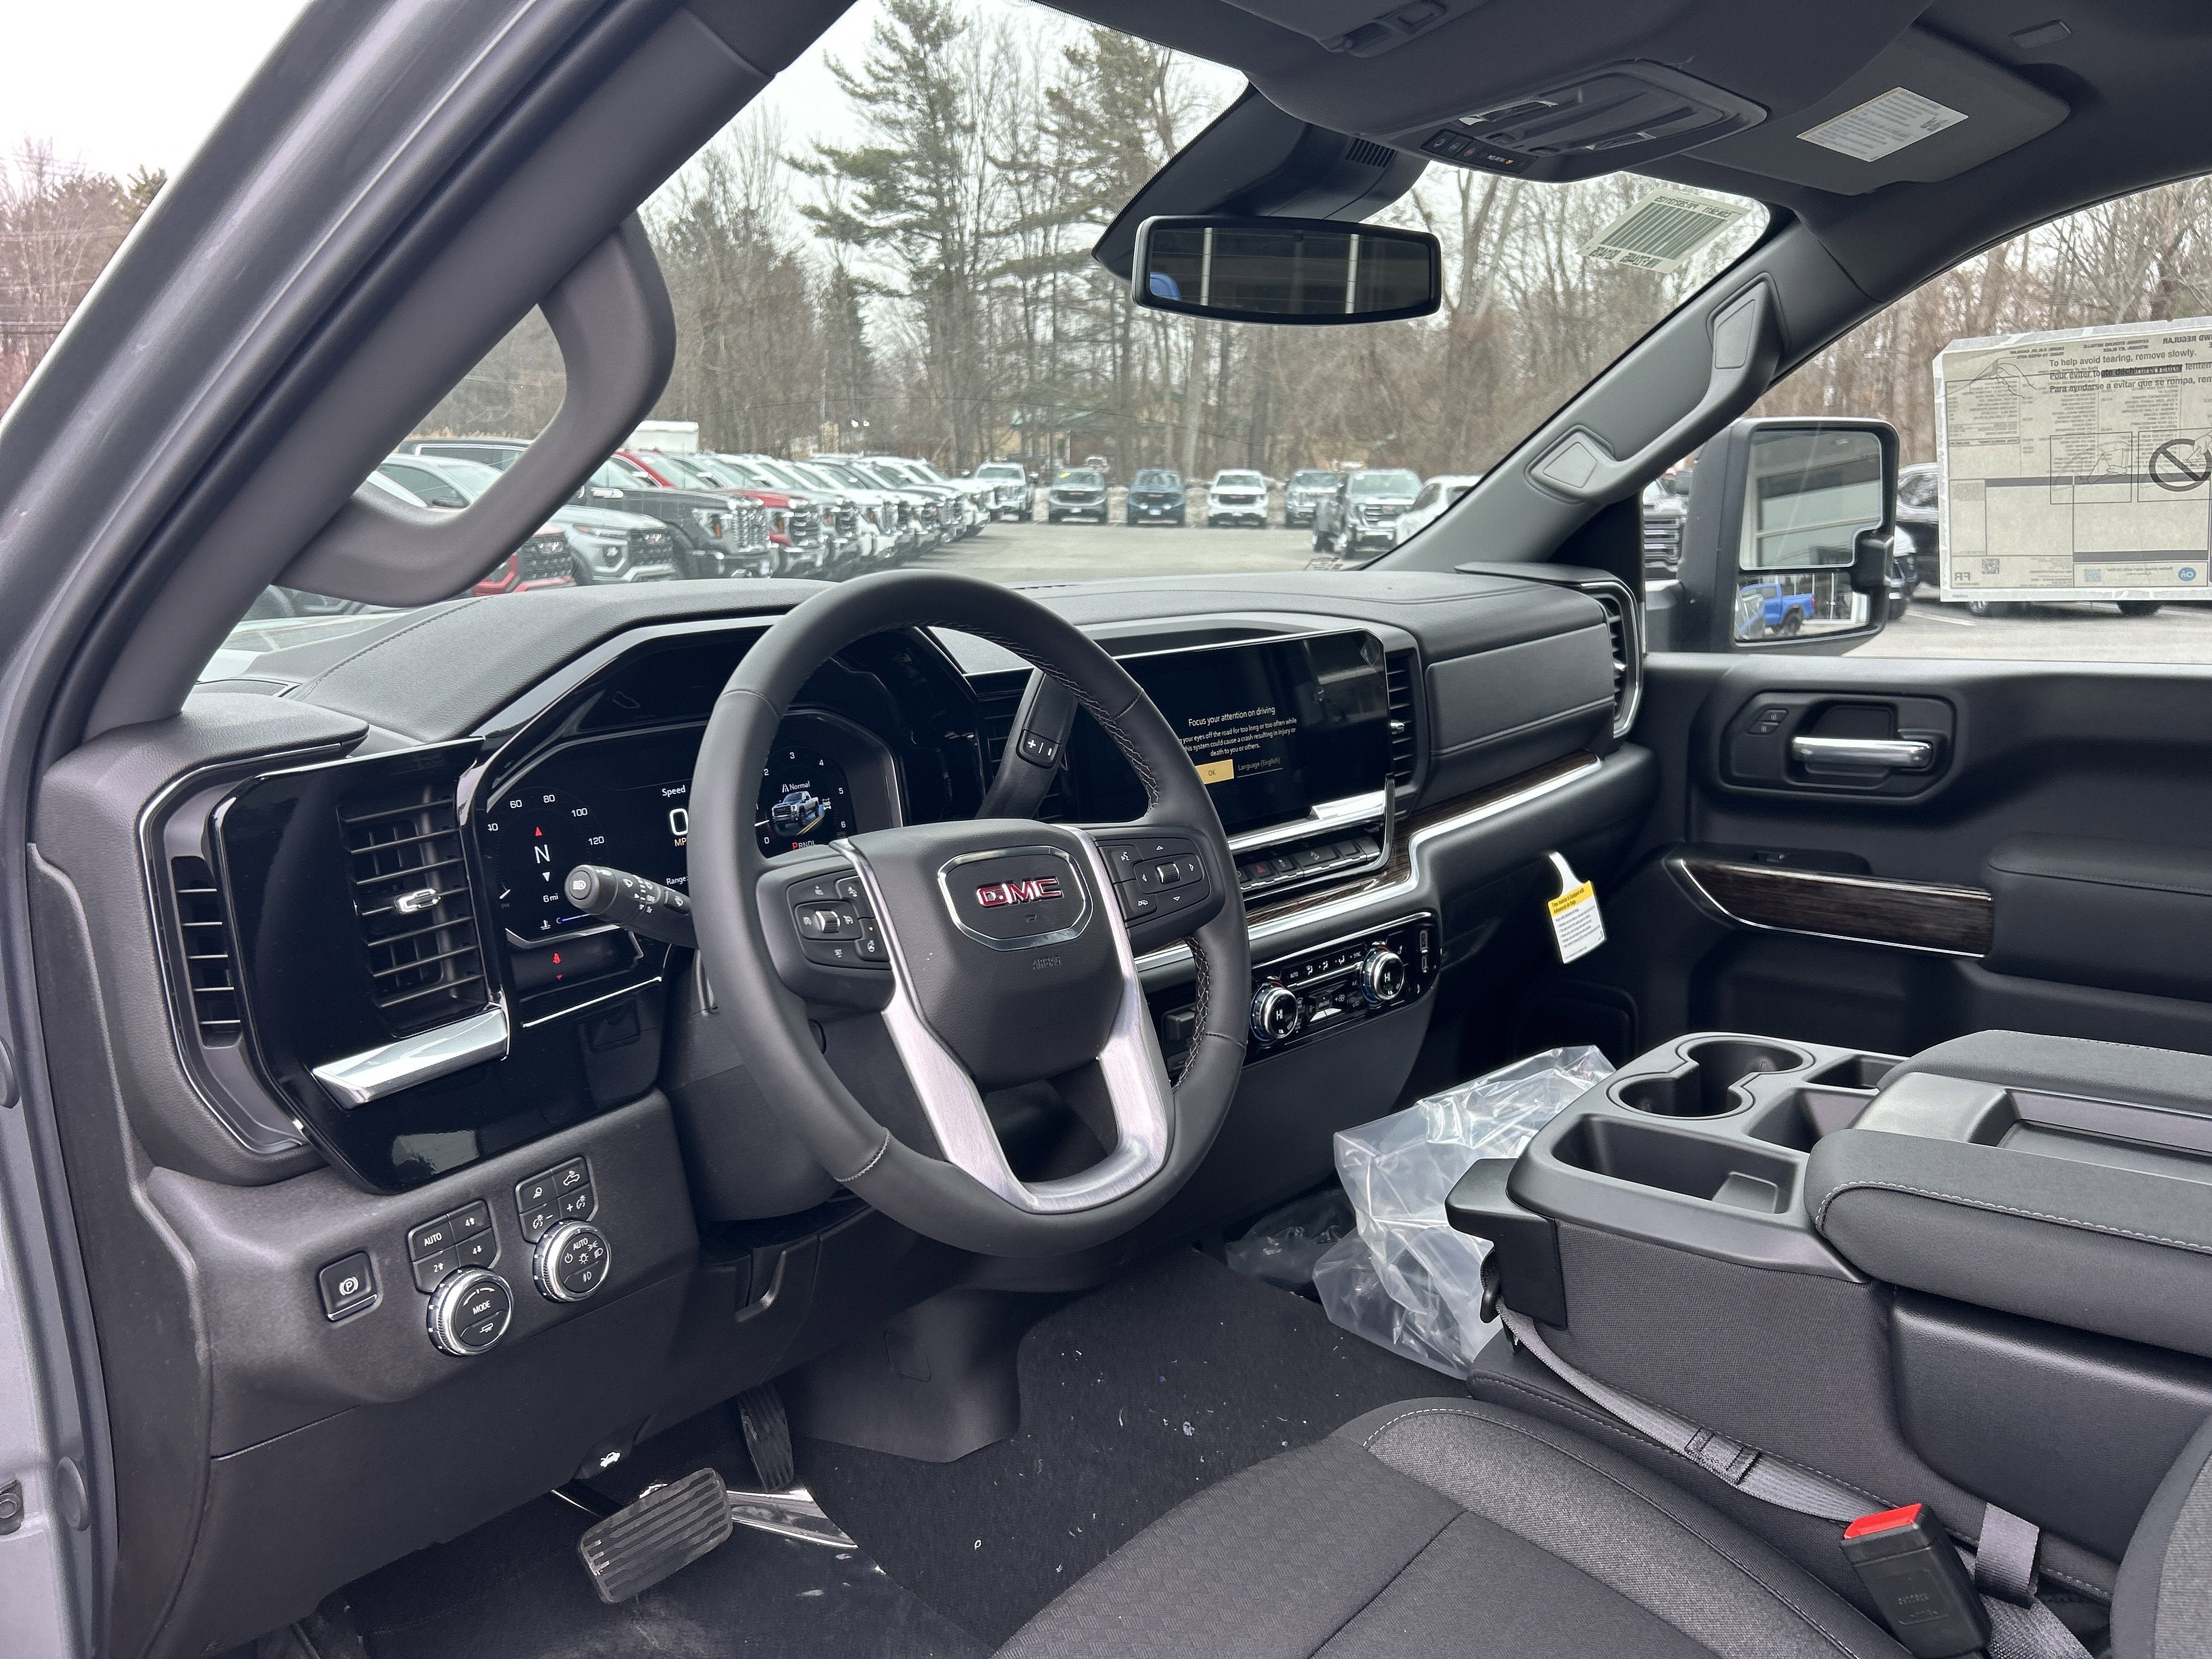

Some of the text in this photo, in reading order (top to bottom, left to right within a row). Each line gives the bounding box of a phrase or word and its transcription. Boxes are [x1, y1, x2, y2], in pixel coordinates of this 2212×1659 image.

[2061, 358, 2078, 366] help
[2079, 356, 2101, 365] avoid
[2103, 354, 2133, 363] tearing,
[2136, 352, 2166, 360] remove
[2168, 348, 2197, 358] slowly.
[2069, 383, 2104, 393] ayudarse
[2168, 377, 2196, 386] rompa,
[1188, 718, 1206, 726] Focus
[1207, 716, 1221, 726] your
[1221, 711, 1248, 721] attention
[1256, 707, 1276, 715] driving
[1183, 736, 1194, 744] your
[1194, 734, 1205, 742] eyes
[1193, 742, 1210, 752] system
[1210, 739, 1223, 747] could
[1241, 733, 1254, 742] crash
[1210, 748, 1224, 757] death
[1238, 757, 1280, 771] Language (English)
[662, 785, 686, 798] Speed
[789, 781, 811, 791] Normal
[510, 799, 523, 809] 60
[543, 794, 555, 803] 80
[571, 808, 588, 817] 100
[670, 808, 689, 836] 0
[588, 836, 605, 845] 120
[674, 837, 687, 847] MP
[534, 844, 550, 864] N
[666, 876, 689, 885] Range:
[977, 878, 1063, 907] GMC
[1384, 972, 1391, 983] HI
[1276, 1008, 1283, 1020] HI
[424, 1232, 442, 1247] AUTO
[573, 1237, 589, 1251] AUTO
[473, 1300, 491, 1316] MODE
